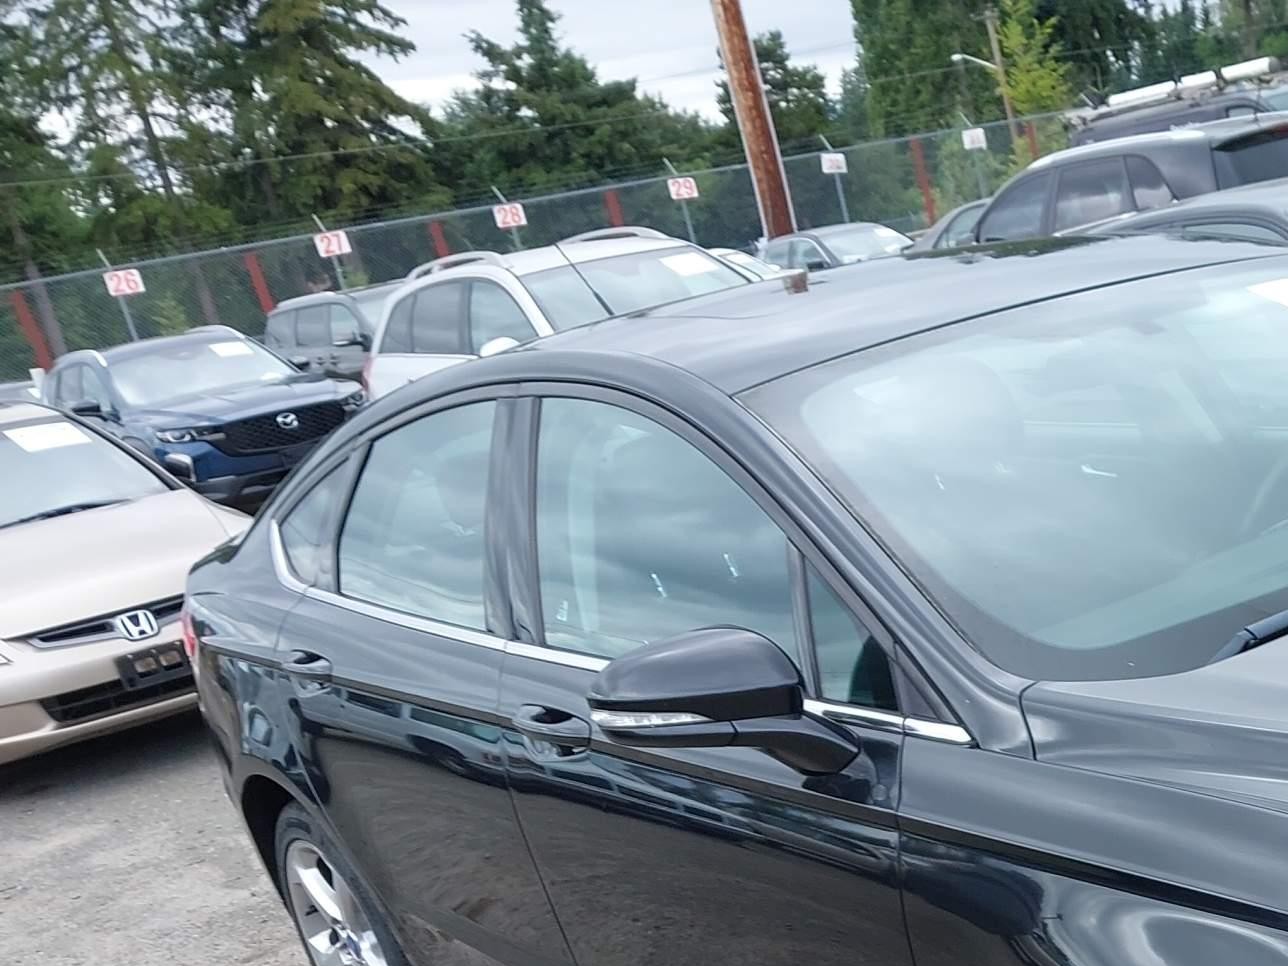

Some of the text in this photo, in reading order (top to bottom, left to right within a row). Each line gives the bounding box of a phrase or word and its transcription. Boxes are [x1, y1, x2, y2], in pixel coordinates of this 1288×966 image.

[671, 179, 694, 197] 29
[497, 205, 522, 226] 28
[320, 233, 343, 254] 27
[110, 271, 139, 293] 26
